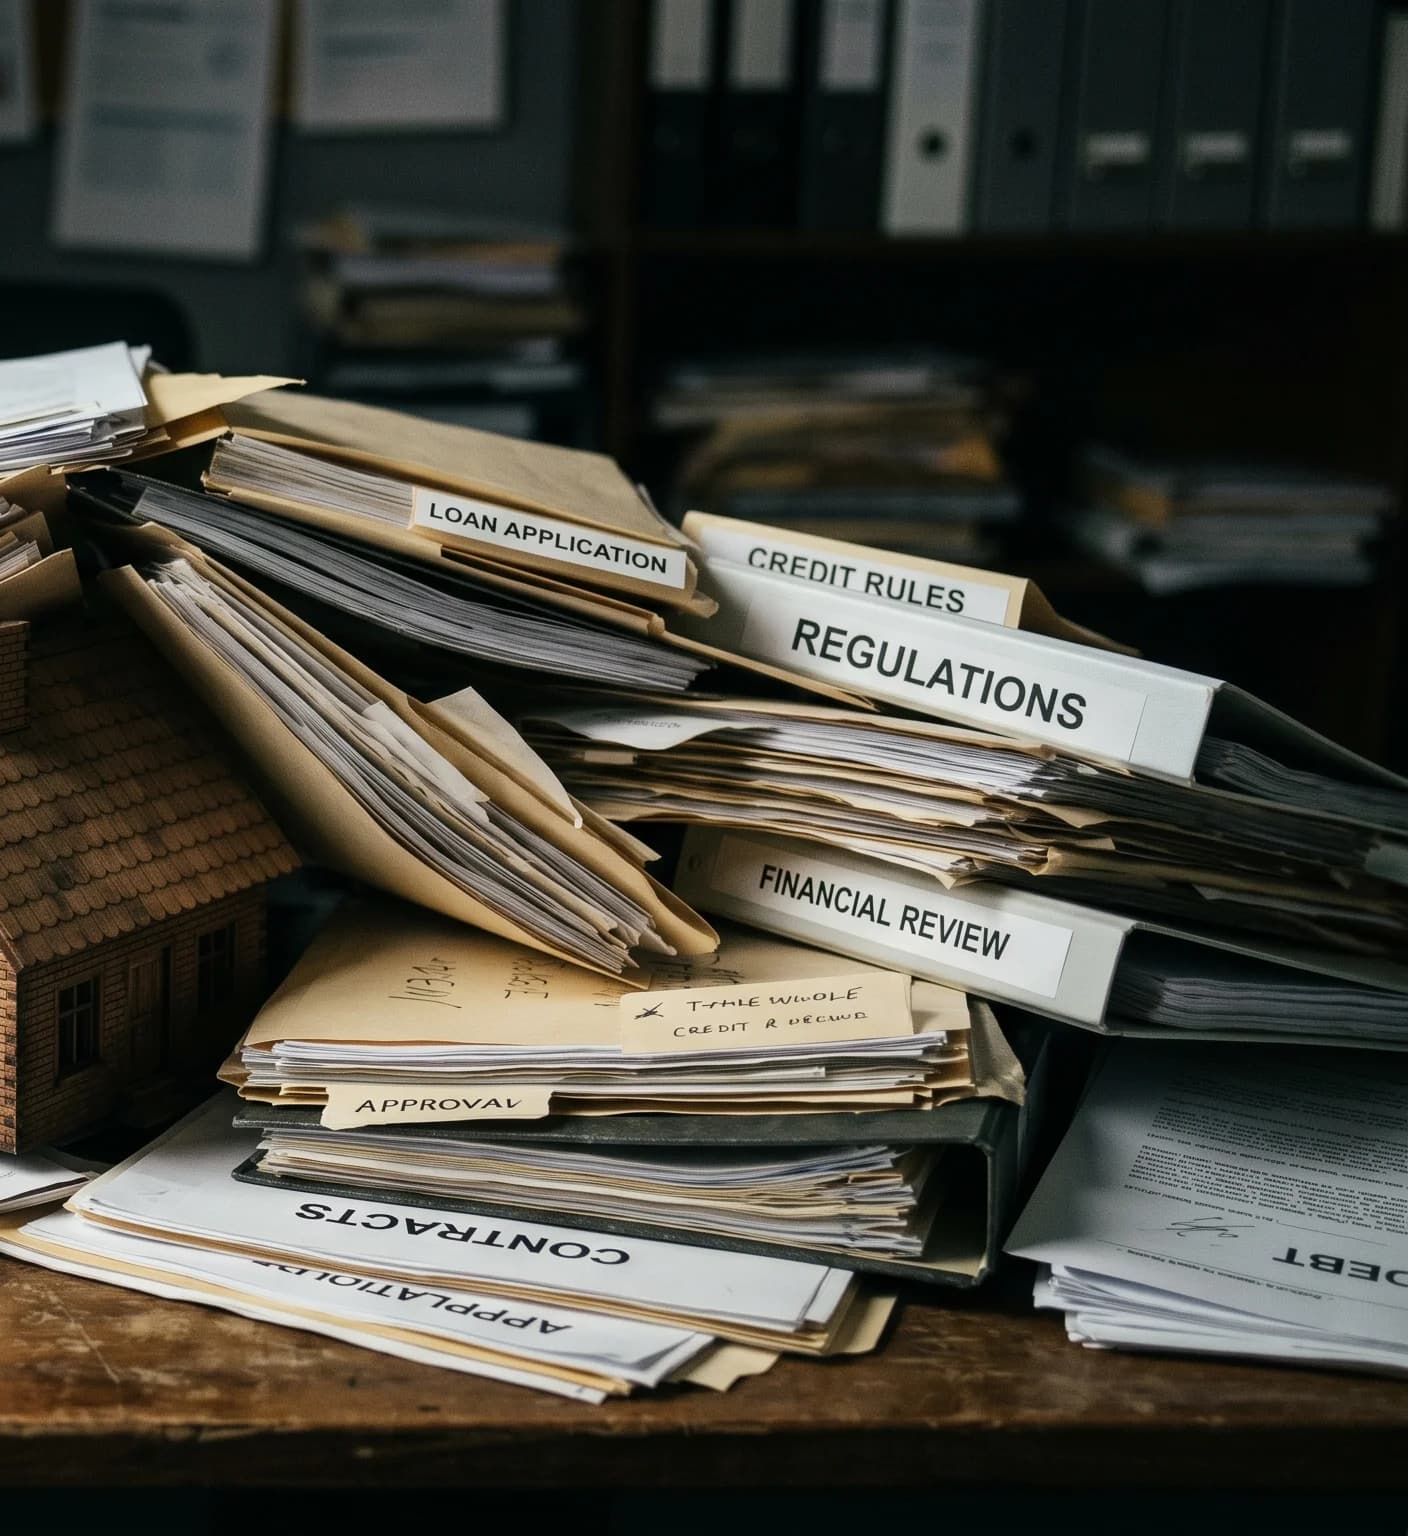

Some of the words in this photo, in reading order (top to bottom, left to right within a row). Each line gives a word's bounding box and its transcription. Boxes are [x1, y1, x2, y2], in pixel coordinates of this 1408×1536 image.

[428, 502, 498, 533] LOAN
[503, 512, 668, 574] APPLICATION
[747, 547, 857, 588] CREDIT
[864, 571, 966, 614] RULES
[791, 618, 1088, 731] REGULATIONS
[757, 862, 891, 928] FINANCIAL
[899, 905, 1012, 961] REVIEW
[672, 1021, 749, 1038] CREDIT
[295, 1203, 631, 1266] CONTRACTS
